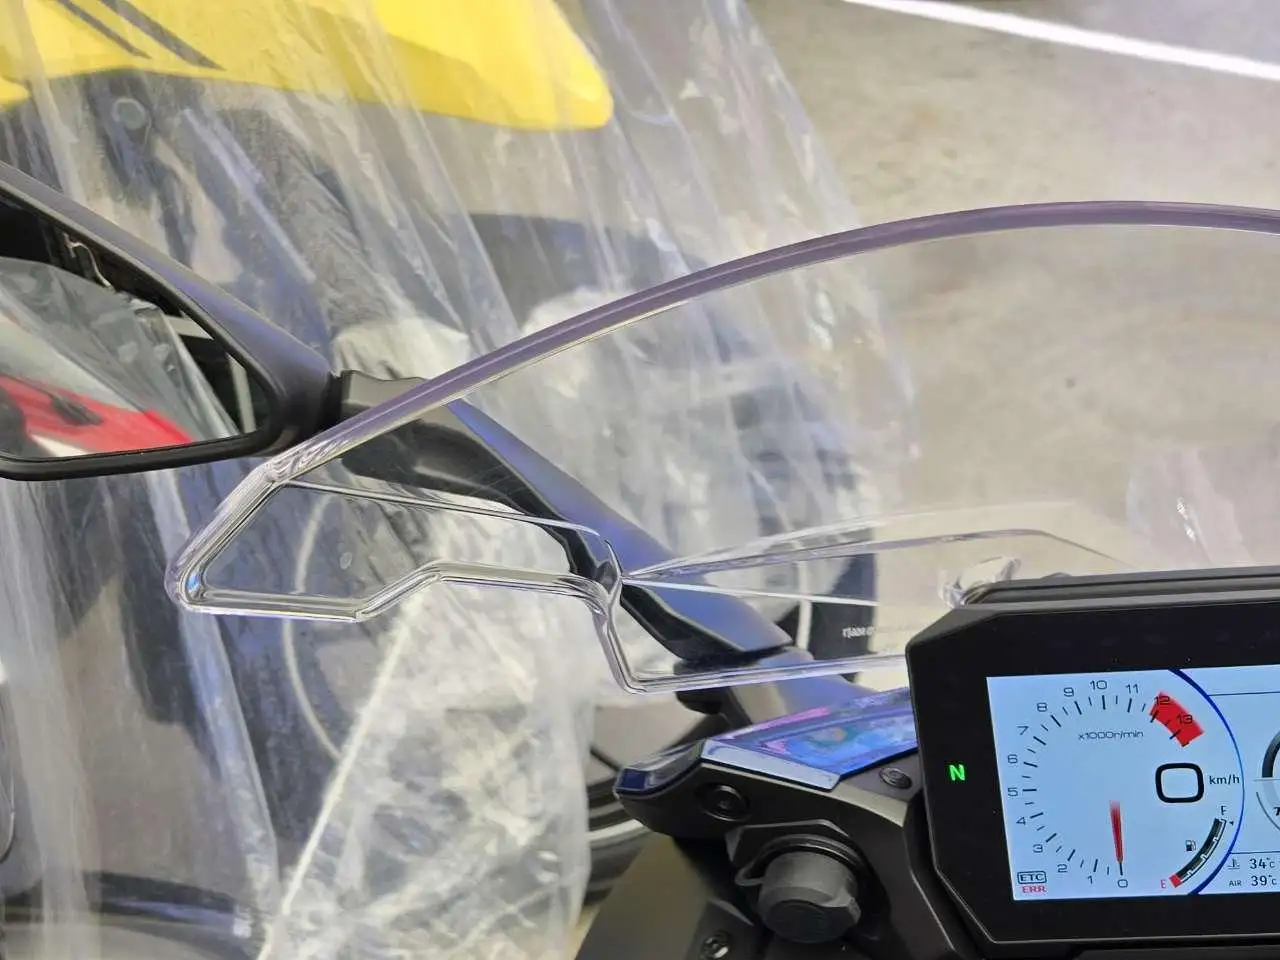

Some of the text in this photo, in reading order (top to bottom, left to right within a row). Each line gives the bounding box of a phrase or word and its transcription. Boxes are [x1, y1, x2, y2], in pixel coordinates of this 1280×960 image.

[1090, 680, 1108, 690] 10
[1126, 684, 1139, 694] 11
[1063, 687, 1075, 697] 9
[1154, 695, 1171, 706] 12
[1037, 702, 1048, 712] 8
[1176, 714, 1193, 724] 13
[1017, 725, 1029, 735] 7
[1007, 754, 1018, 764] 6
[949, 764, 965, 781] N
[1155, 763, 1240, 803] 0 km/h
[1008, 787, 1019, 797] 5
[1221, 805, 1227, 815] F
[1016, 816, 1026, 826] 4
[1032, 844, 1043, 853] 3
[1057, 863, 1068, 873] 2
[1020, 873, 1045, 882] ETC
[1087, 876, 1093, 884] 1
[1117, 879, 1128, 888] 0
[1160, 880, 1166, 889] E
[1022, 886, 1047, 894] ERR
